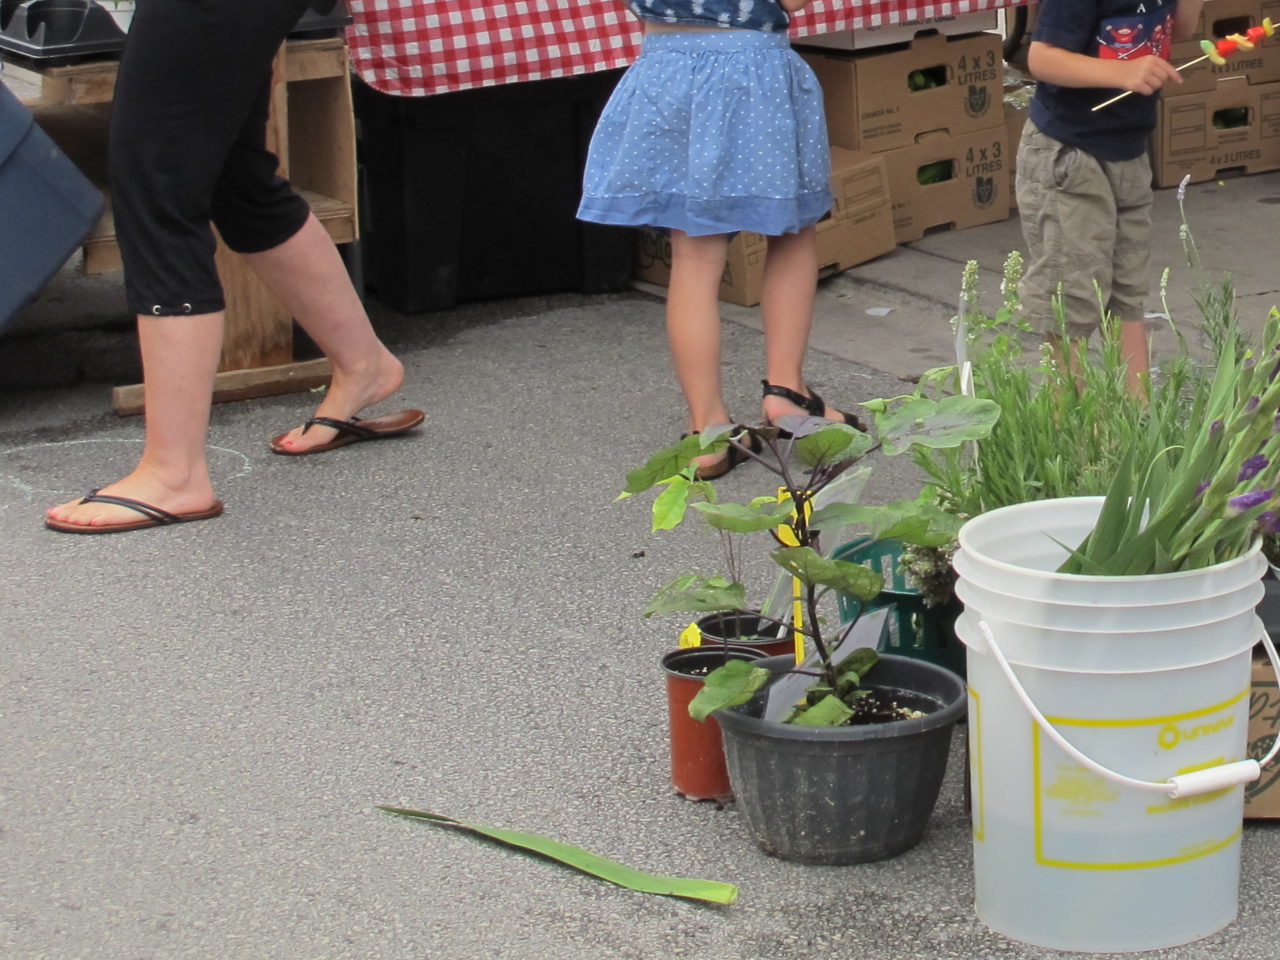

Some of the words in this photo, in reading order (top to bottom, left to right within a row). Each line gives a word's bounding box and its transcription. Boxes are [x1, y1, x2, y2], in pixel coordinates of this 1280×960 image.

[958, 55, 967, 71] 4
[972, 58, 981, 69] x
[987, 51, 996, 68] 3
[1210, 64, 1217, 74] 4
[1233, 58, 1263, 71] LITRES
[958, 68, 997, 85] LITRES
[966, 147, 974, 163] 4
[980, 150, 988, 161] x
[993, 142, 1001, 159] 3
[1210, 156, 1216, 165] 4
[1224, 153, 1230, 163] 3
[1232, 148, 1262, 162] LITRES
[966, 160, 1002, 178] LITRES
